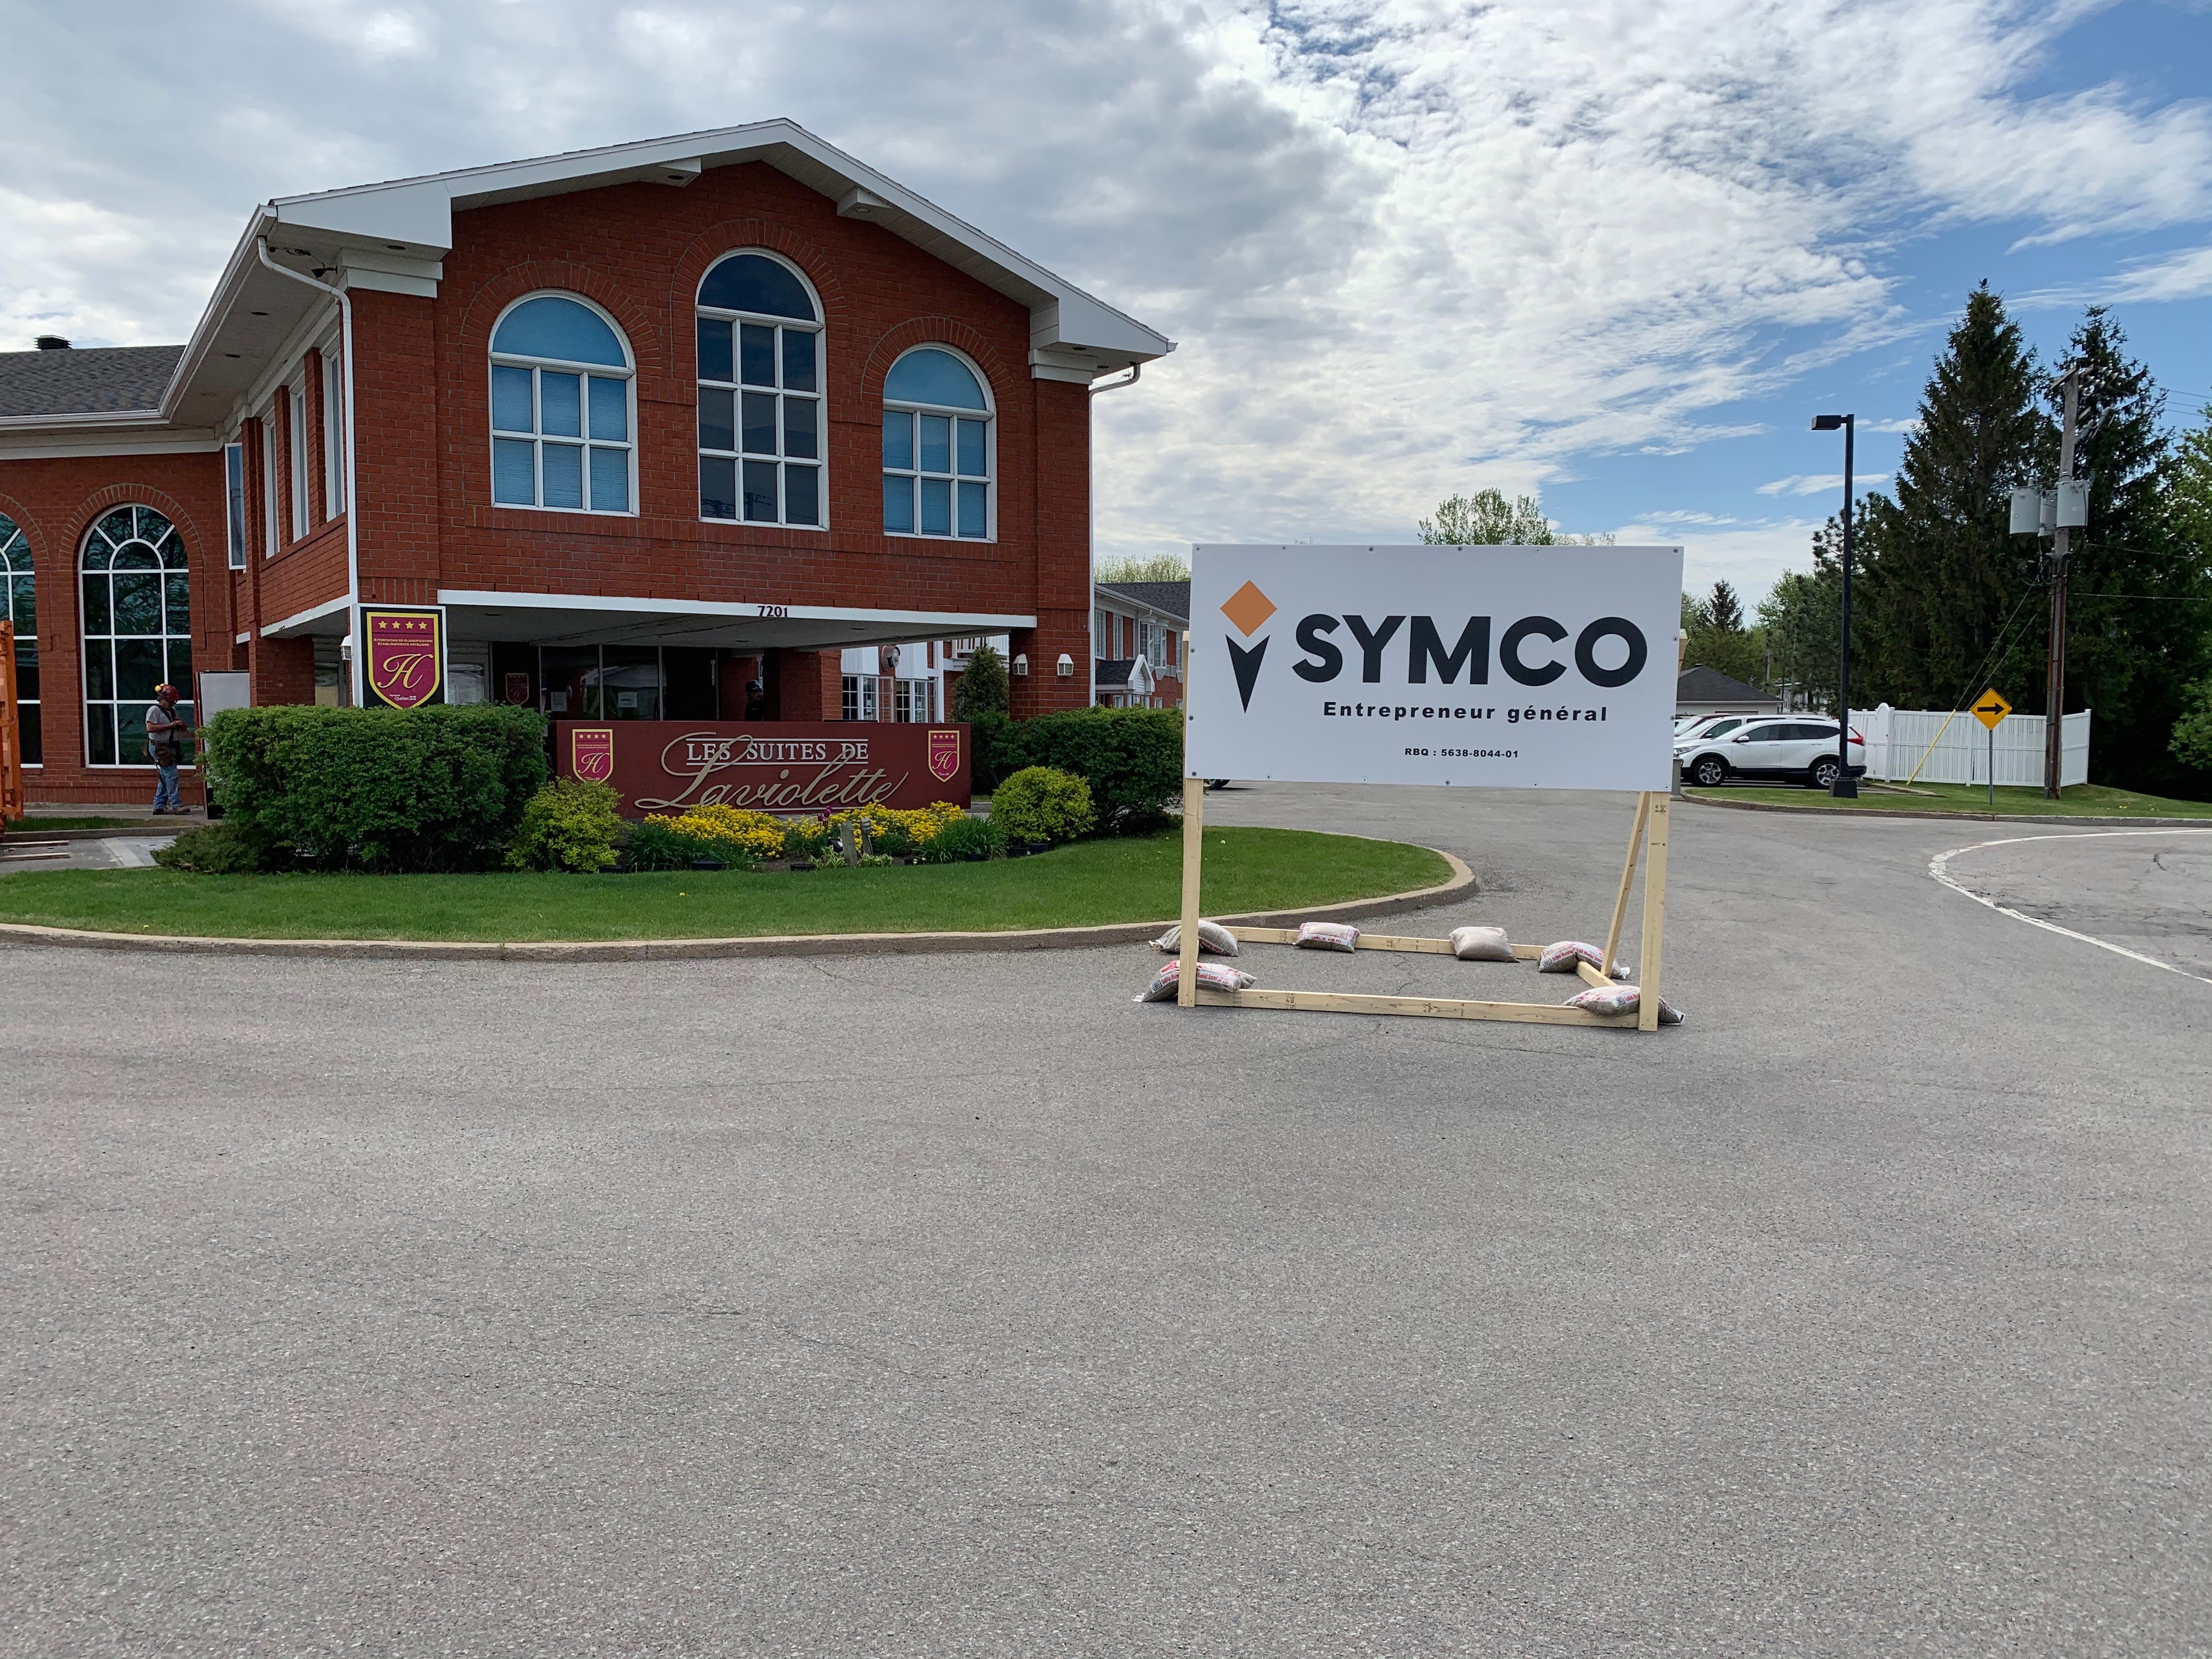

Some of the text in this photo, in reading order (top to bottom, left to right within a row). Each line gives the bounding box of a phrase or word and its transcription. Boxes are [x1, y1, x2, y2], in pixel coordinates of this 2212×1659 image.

[758, 606, 788, 617] 7201
[1291, 613, 1648, 689] SYMCO
[1323, 702, 1607, 724] Entrepreneur général
[686, 742, 868, 761] LES SUITES DE
[1404, 748, 1429, 757] RBQ
[1441, 749, 1519, 758] 5638-8044-01
[634, 731, 910, 809] Laviolette
